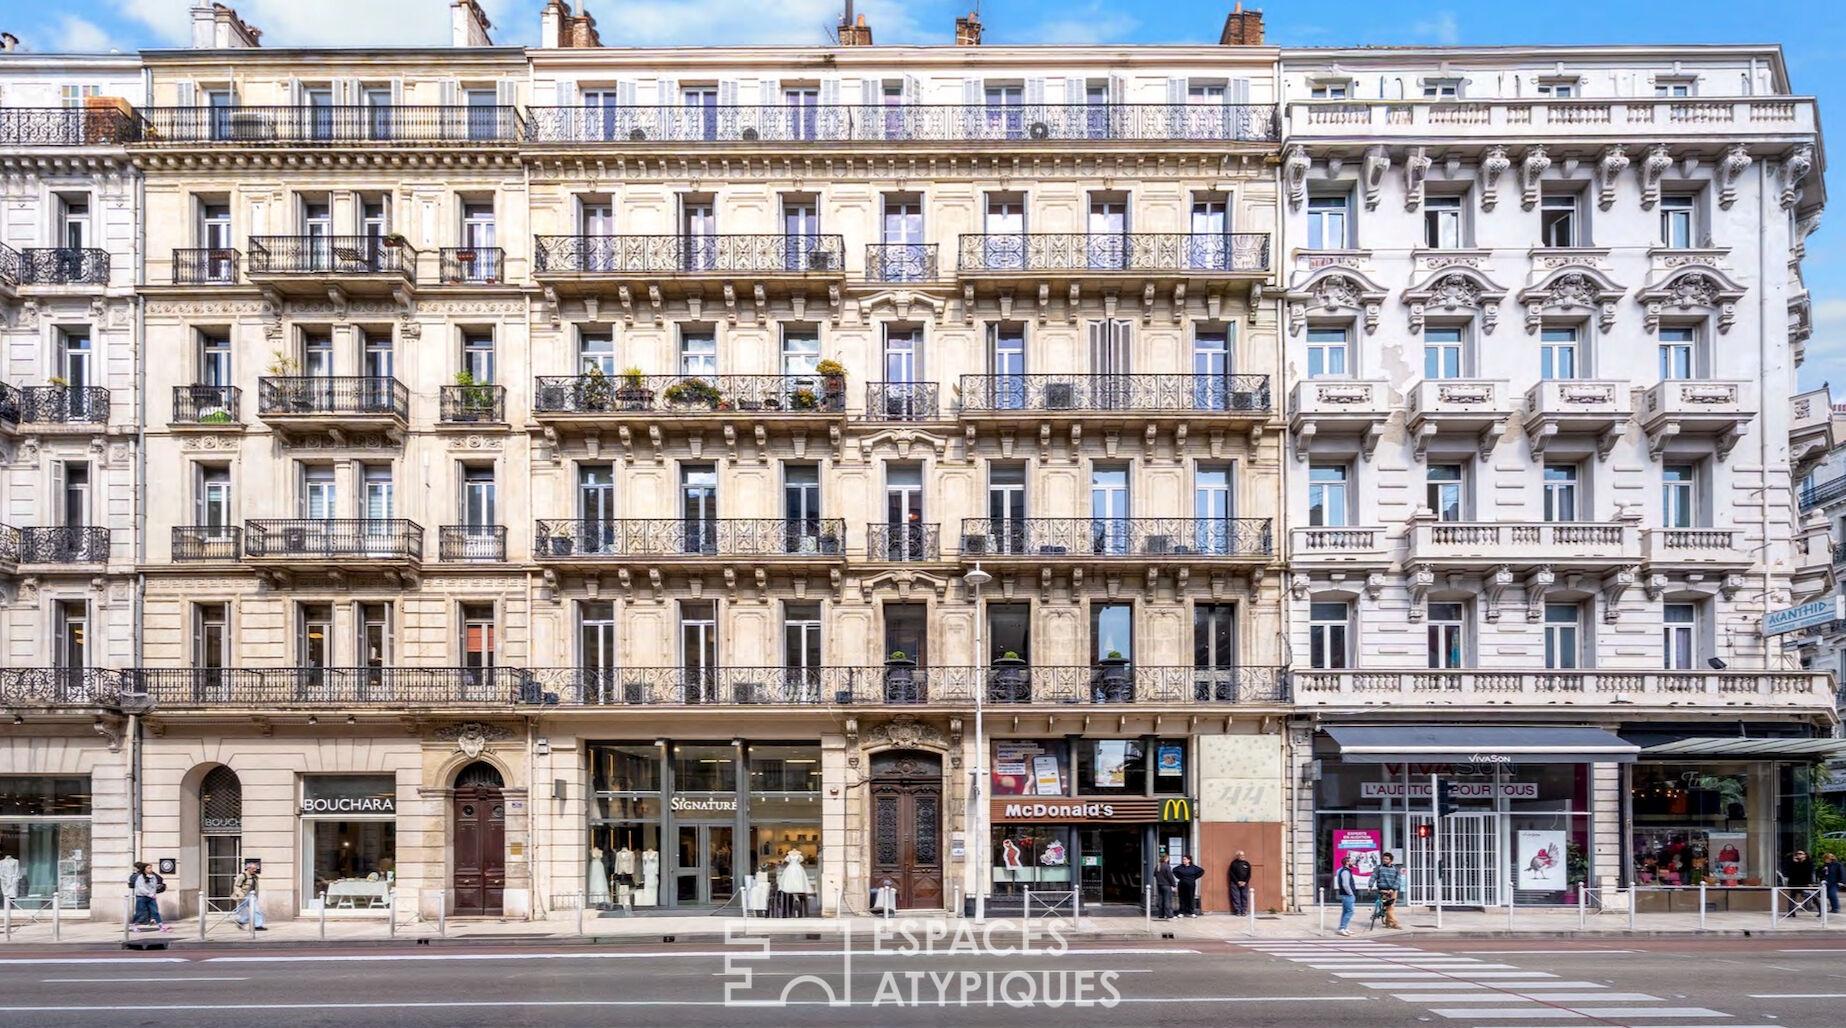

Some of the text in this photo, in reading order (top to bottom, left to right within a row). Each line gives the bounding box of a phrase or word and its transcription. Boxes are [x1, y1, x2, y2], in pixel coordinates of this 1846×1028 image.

[1365, 784, 1434, 795] L'AUDITIO
[1451, 784, 1492, 795] POUR
[303, 799, 394, 811] BOUCHARA
[1005, 803, 1114, 817] McDonald's
